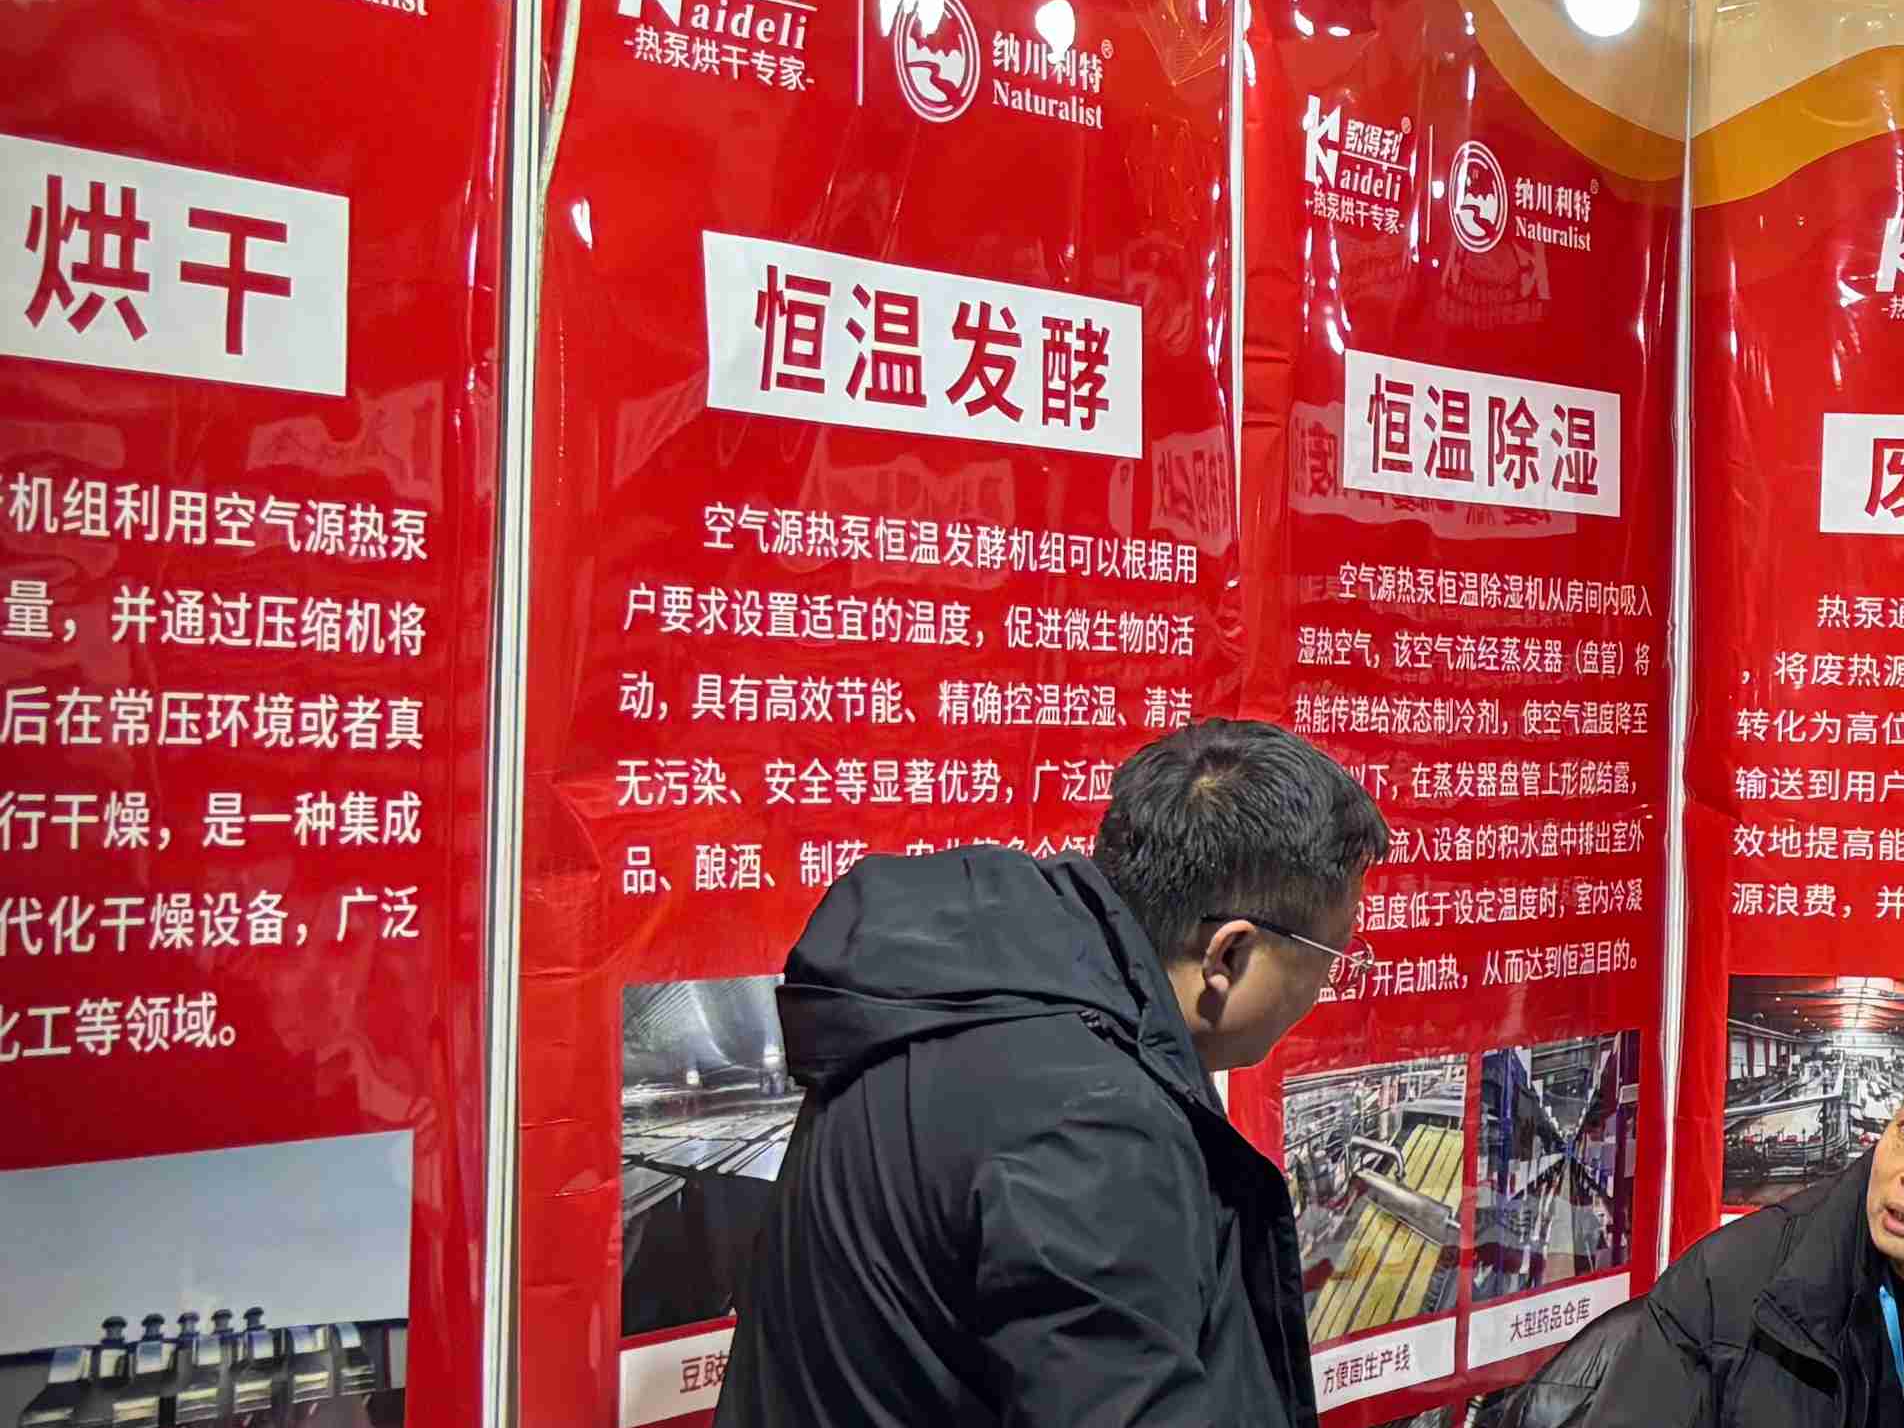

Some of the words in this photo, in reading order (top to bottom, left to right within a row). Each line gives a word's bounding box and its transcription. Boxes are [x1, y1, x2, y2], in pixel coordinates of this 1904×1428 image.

[992, 79, 1103, 130] Naturalist
[1515, 176, 1591, 224] 纳川利特
[1515, 215, 1591, 252] Naturalist
[24, 174, 292, 355] 烘干
[755, 265, 1110, 431] 恒温发酵
[1367, 372, 1599, 496] 恒温除湿
[0, 474, 428, 562] 机组利用空气源热泵
[703, 501, 1199, 585] 空气源热泵恒温发酵机组可以根据用
[2, 579, 426, 657] 量，并通过压缩机将
[623, 582, 1196, 657] 户要求设置适宜的温度，促进微生物的活
[1, 686, 424, 752] 后在常压环境或者真
[1343, 760, 1638, 801] 以下，在蒸发器盘管上形成结露，
[0, 791, 423, 851] 行干燥，是一种集成
[1376, 819, 1645, 866] 流入设备的积水盘中排出室外
